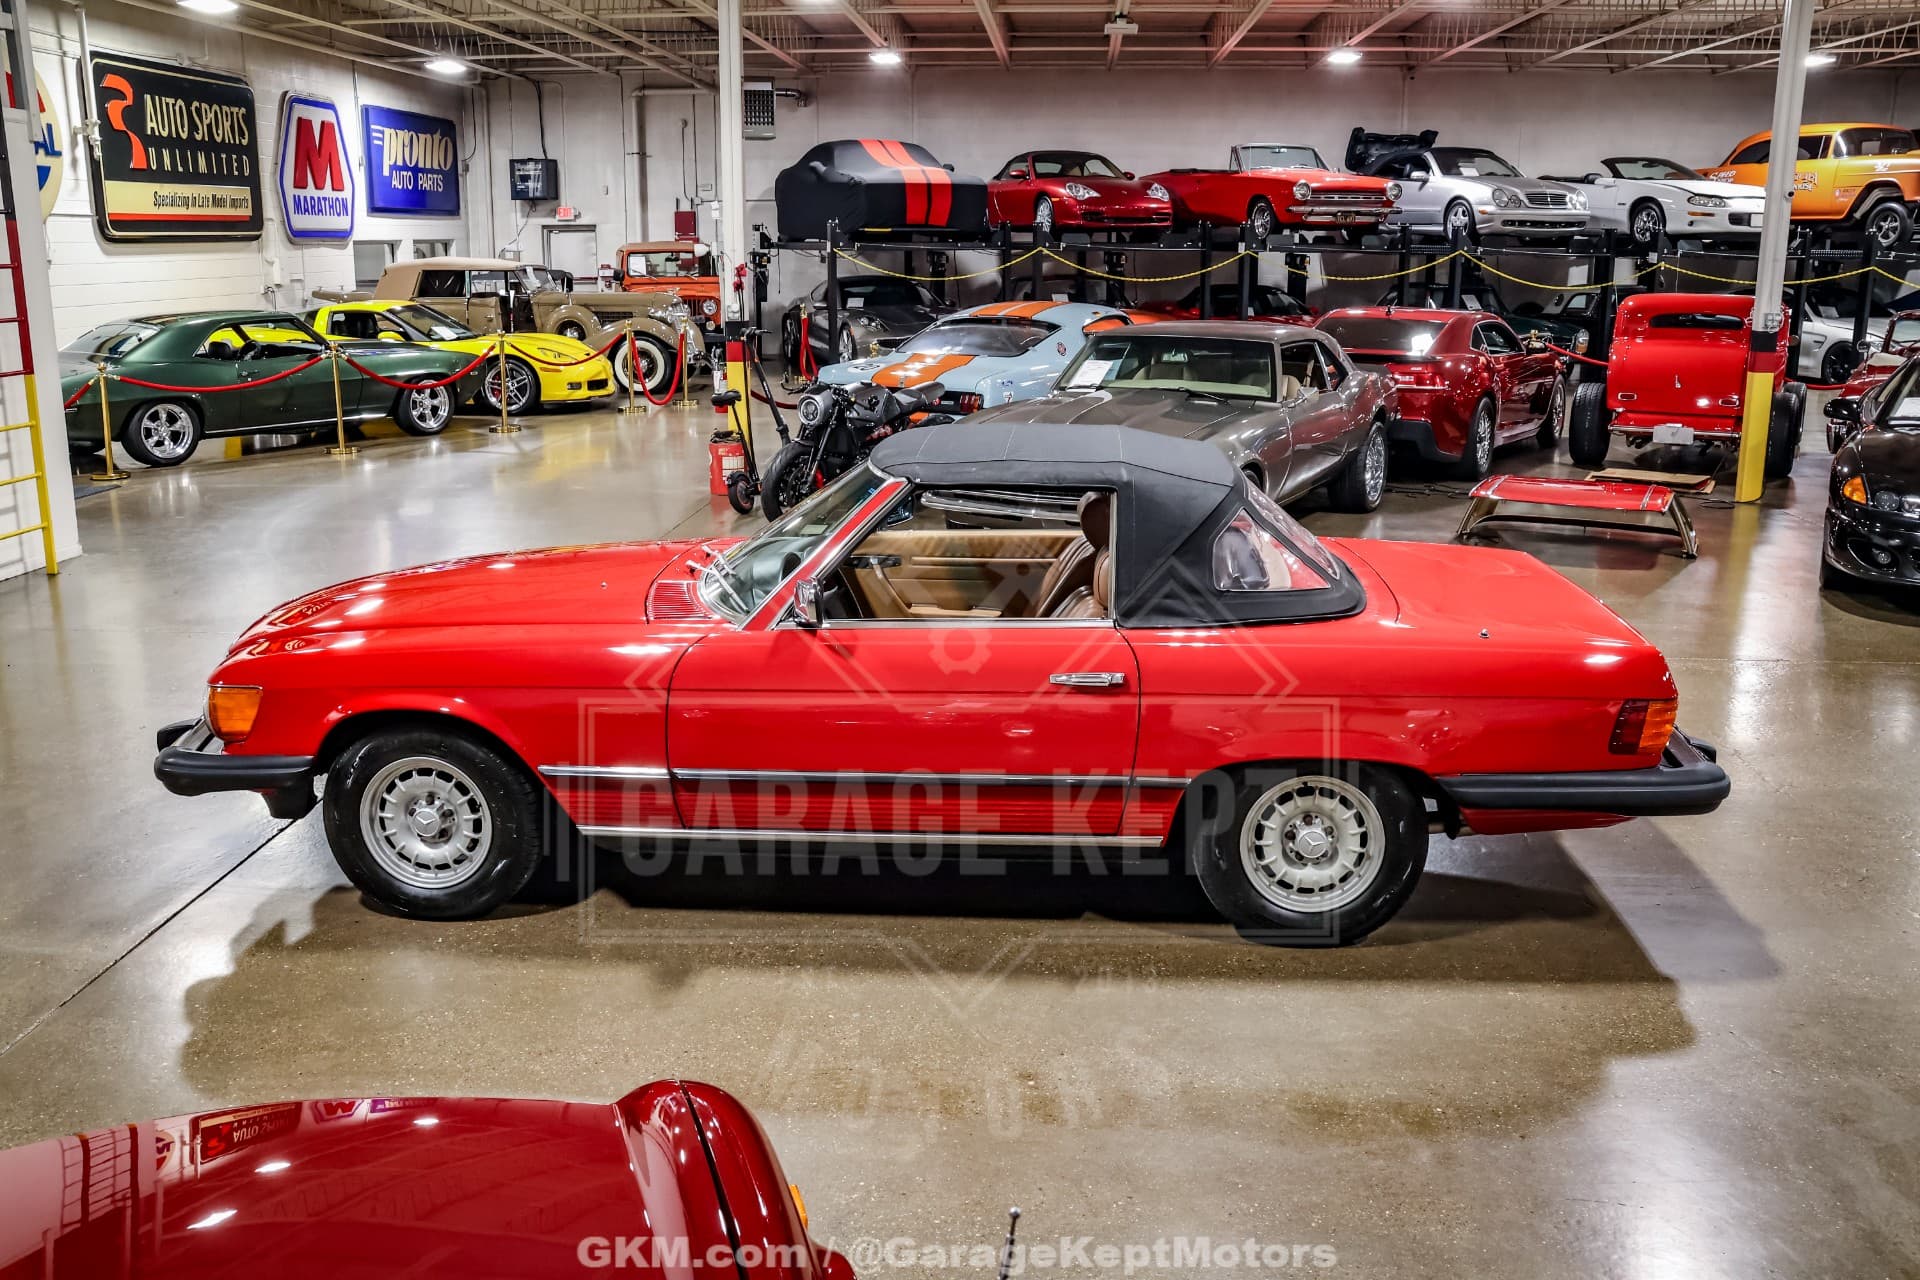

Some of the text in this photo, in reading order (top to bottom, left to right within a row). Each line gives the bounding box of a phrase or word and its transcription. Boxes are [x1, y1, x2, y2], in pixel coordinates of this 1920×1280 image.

[144, 94, 249, 146] AUTO SPORTS
[147, 147, 250, 177] UNLIMITED
[293, 117, 345, 191] M
[382, 127, 454, 177] pronto
[391, 171, 443, 192] AUTO PARTS
[153, 191, 190, 210] Specializing
[198, 194, 210, 208] Late
[211, 194, 228, 209] Model
[229, 195, 249, 211] Imports
[293, 194, 349, 217] MARATHON
